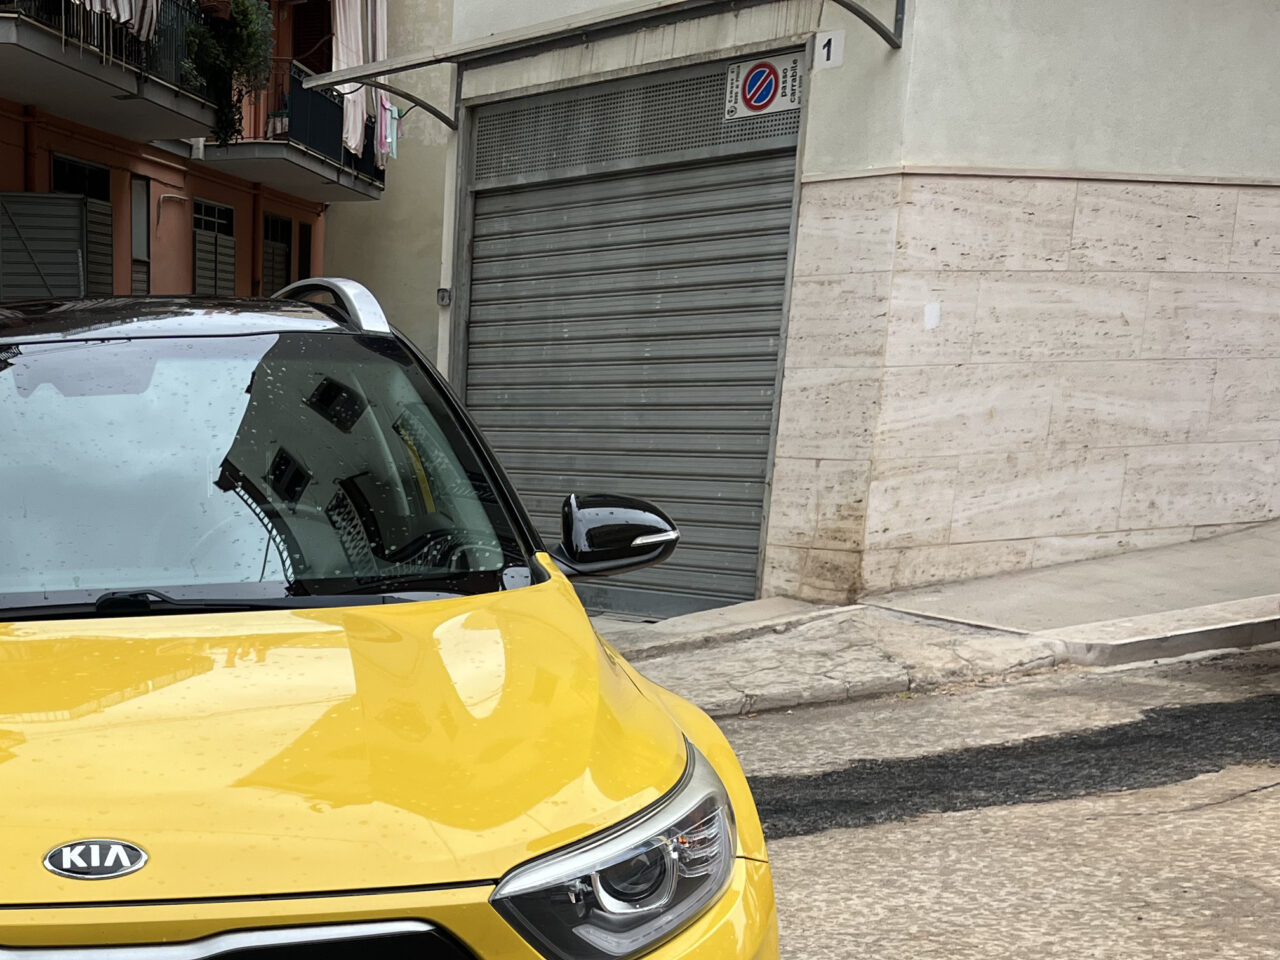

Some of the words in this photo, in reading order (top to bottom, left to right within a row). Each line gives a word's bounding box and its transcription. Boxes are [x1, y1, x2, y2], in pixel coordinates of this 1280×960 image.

[822, 38, 833, 61] 1
[781, 67, 789, 98] passo
[790, 58, 799, 103] carrabile
[61, 844, 132, 869] KIA
